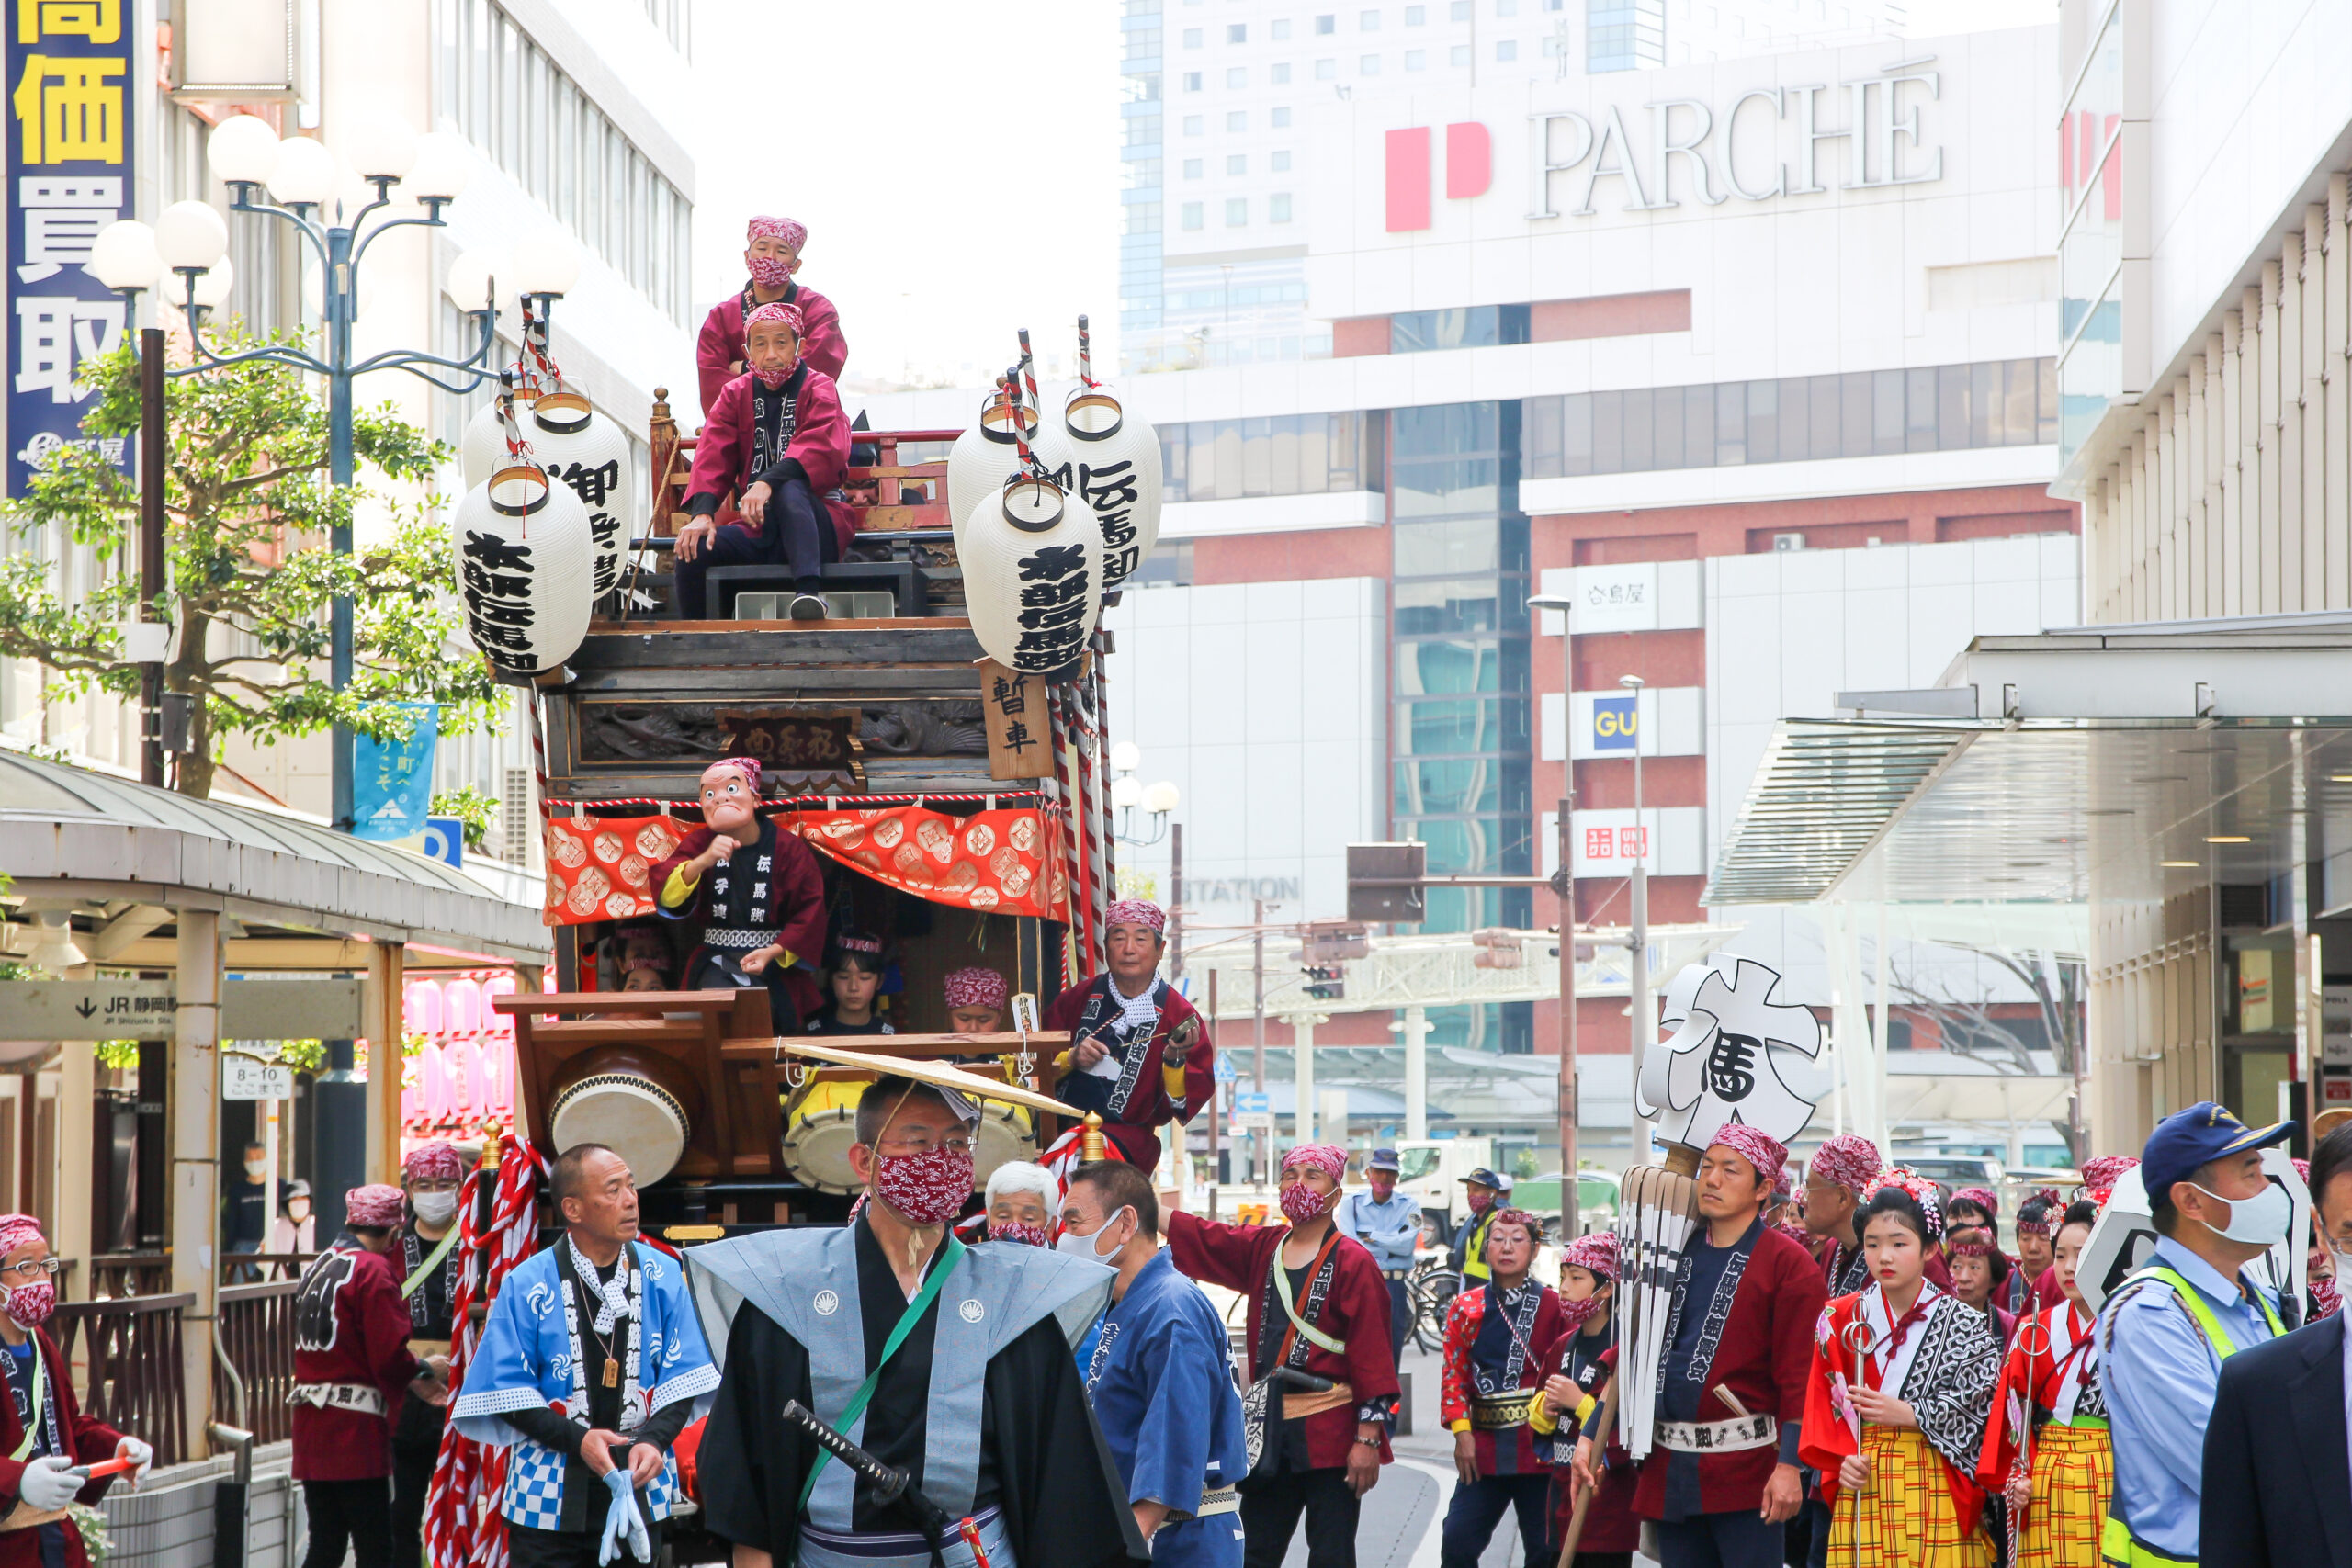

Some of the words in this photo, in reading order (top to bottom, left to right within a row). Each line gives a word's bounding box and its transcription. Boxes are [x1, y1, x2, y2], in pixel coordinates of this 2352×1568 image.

[1523, 54, 1944, 220] PARCHÉ
[1595, 711, 1636, 737] GU
[104, 997, 129, 1014] JR
[1701, 1026, 1763, 1103] 馬
[232, 1083, 283, 1096] ここまで
